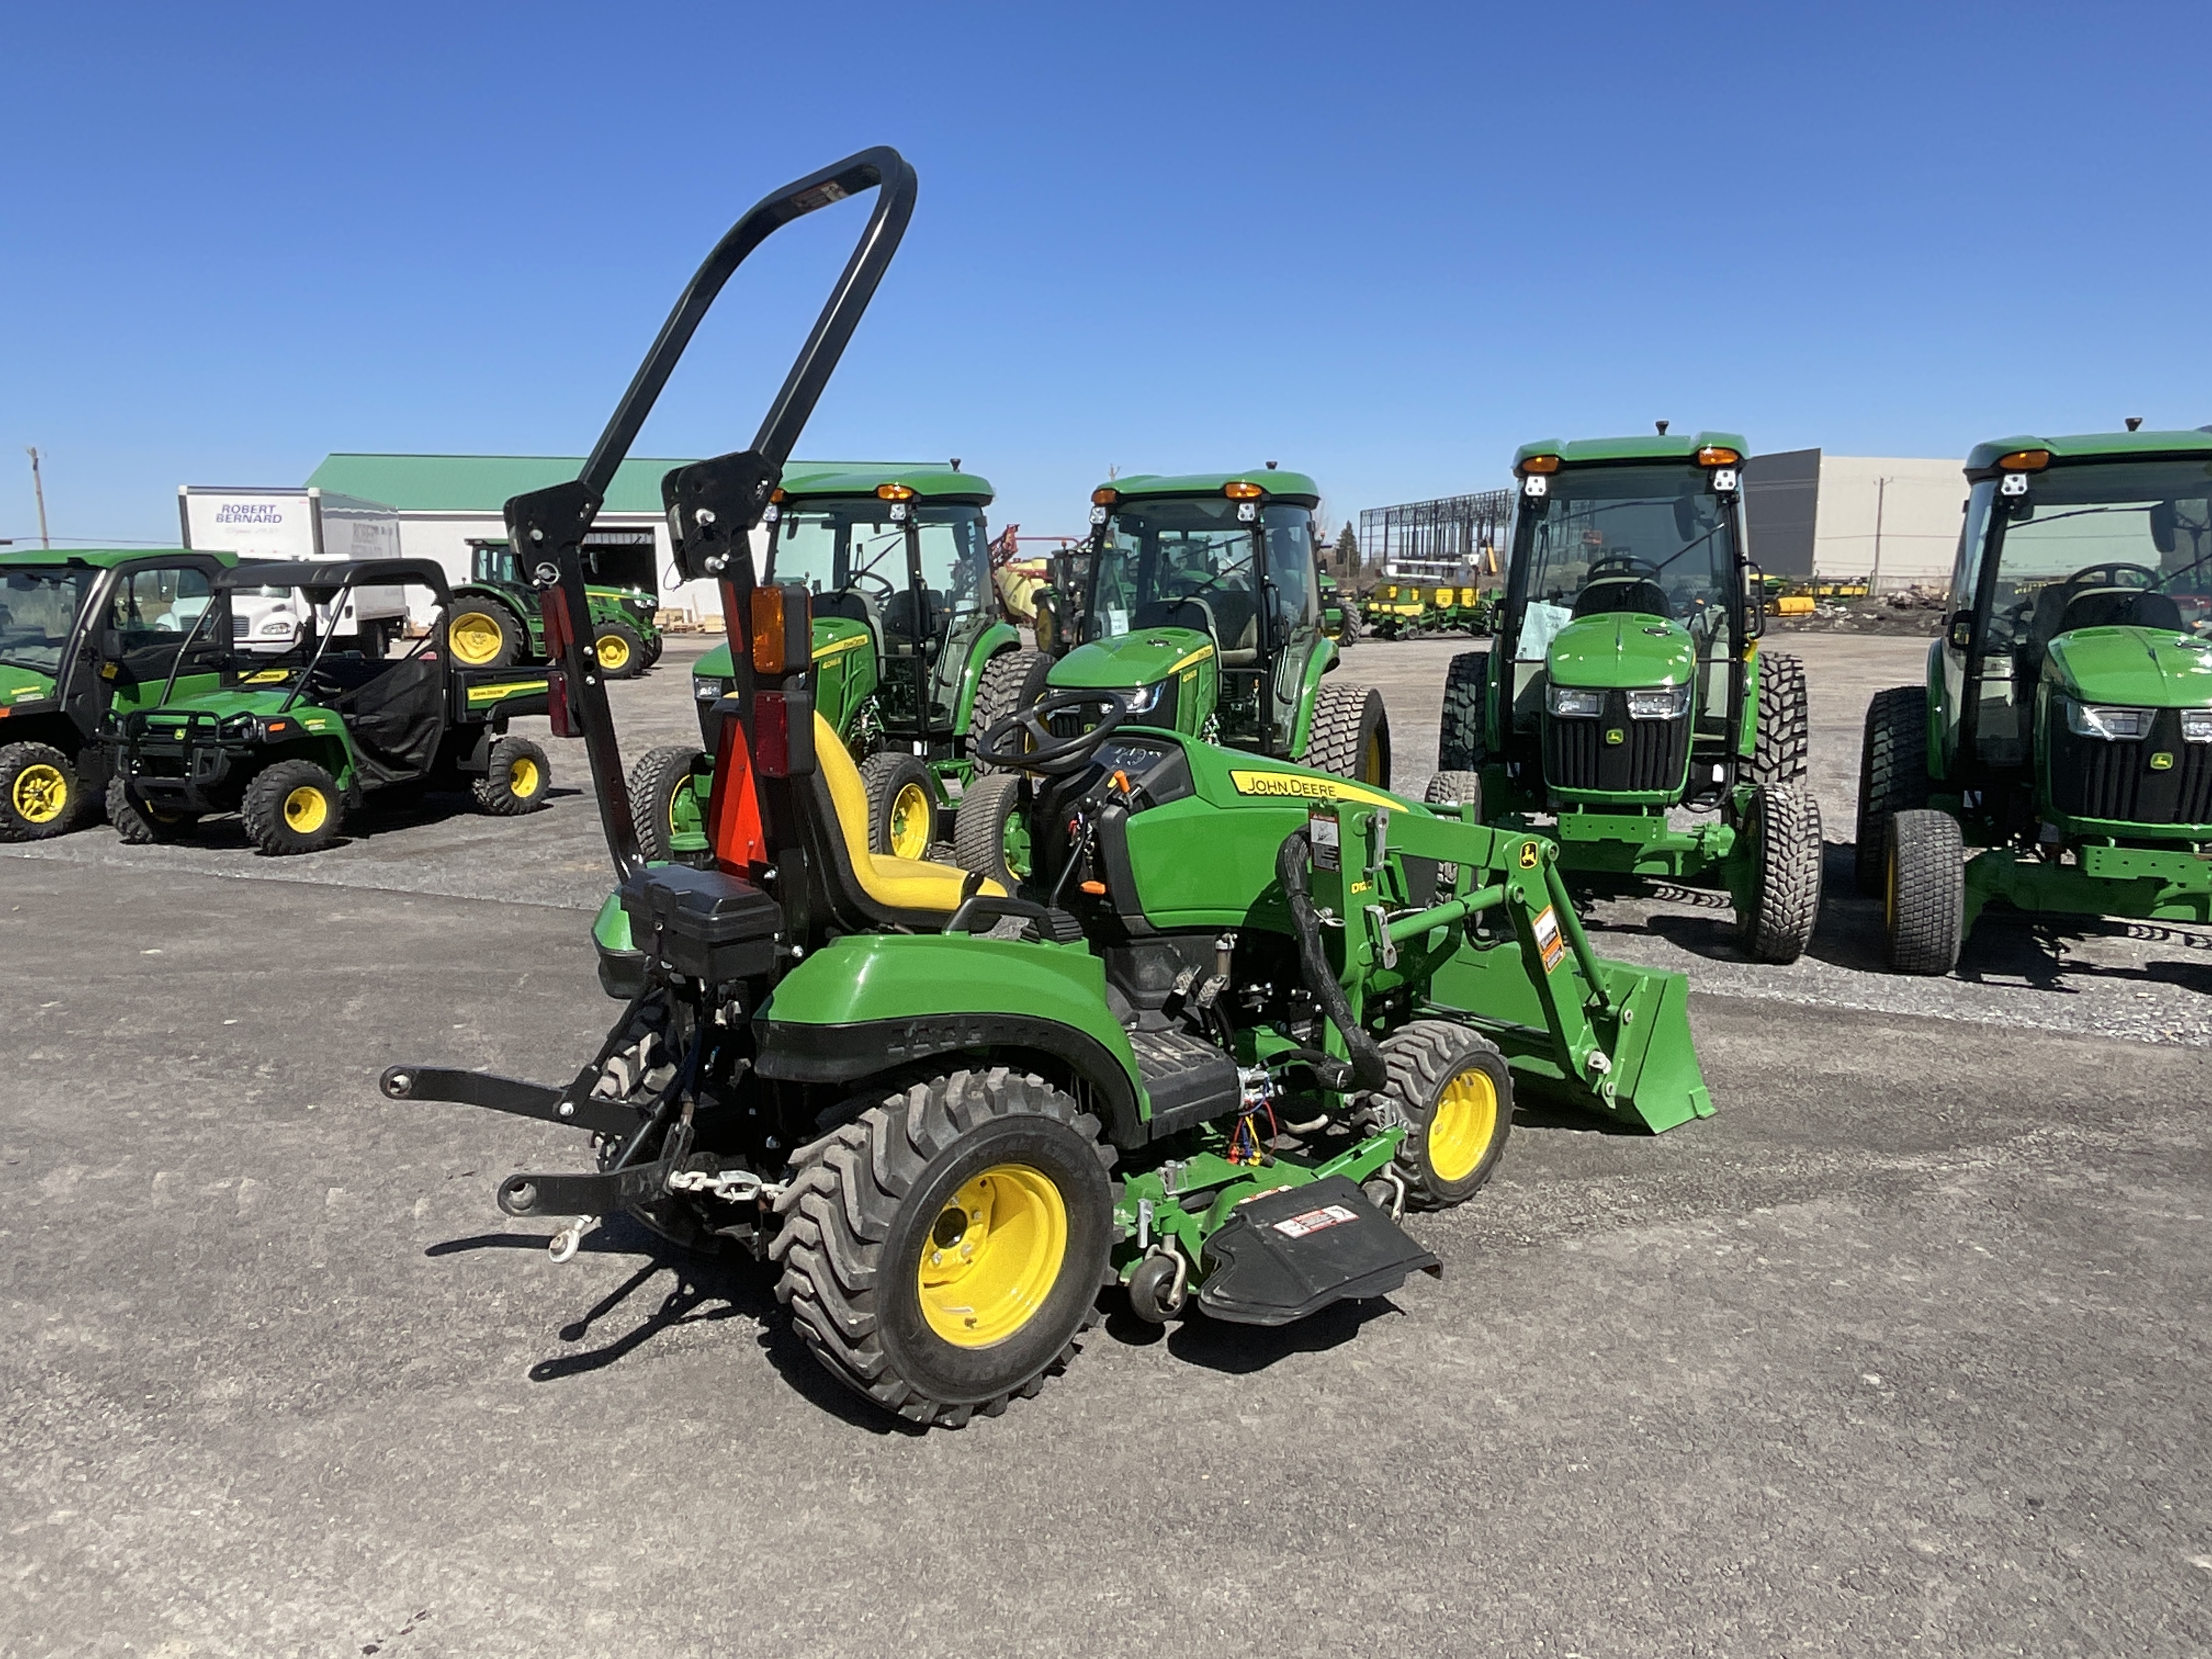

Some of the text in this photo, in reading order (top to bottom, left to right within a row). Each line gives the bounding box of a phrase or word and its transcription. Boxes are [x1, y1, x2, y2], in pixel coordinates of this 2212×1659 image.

[221, 504, 276, 514] ROBERT
[216, 514, 283, 523] BERNARD
[1248, 777, 1336, 797] JOHN DEERE
